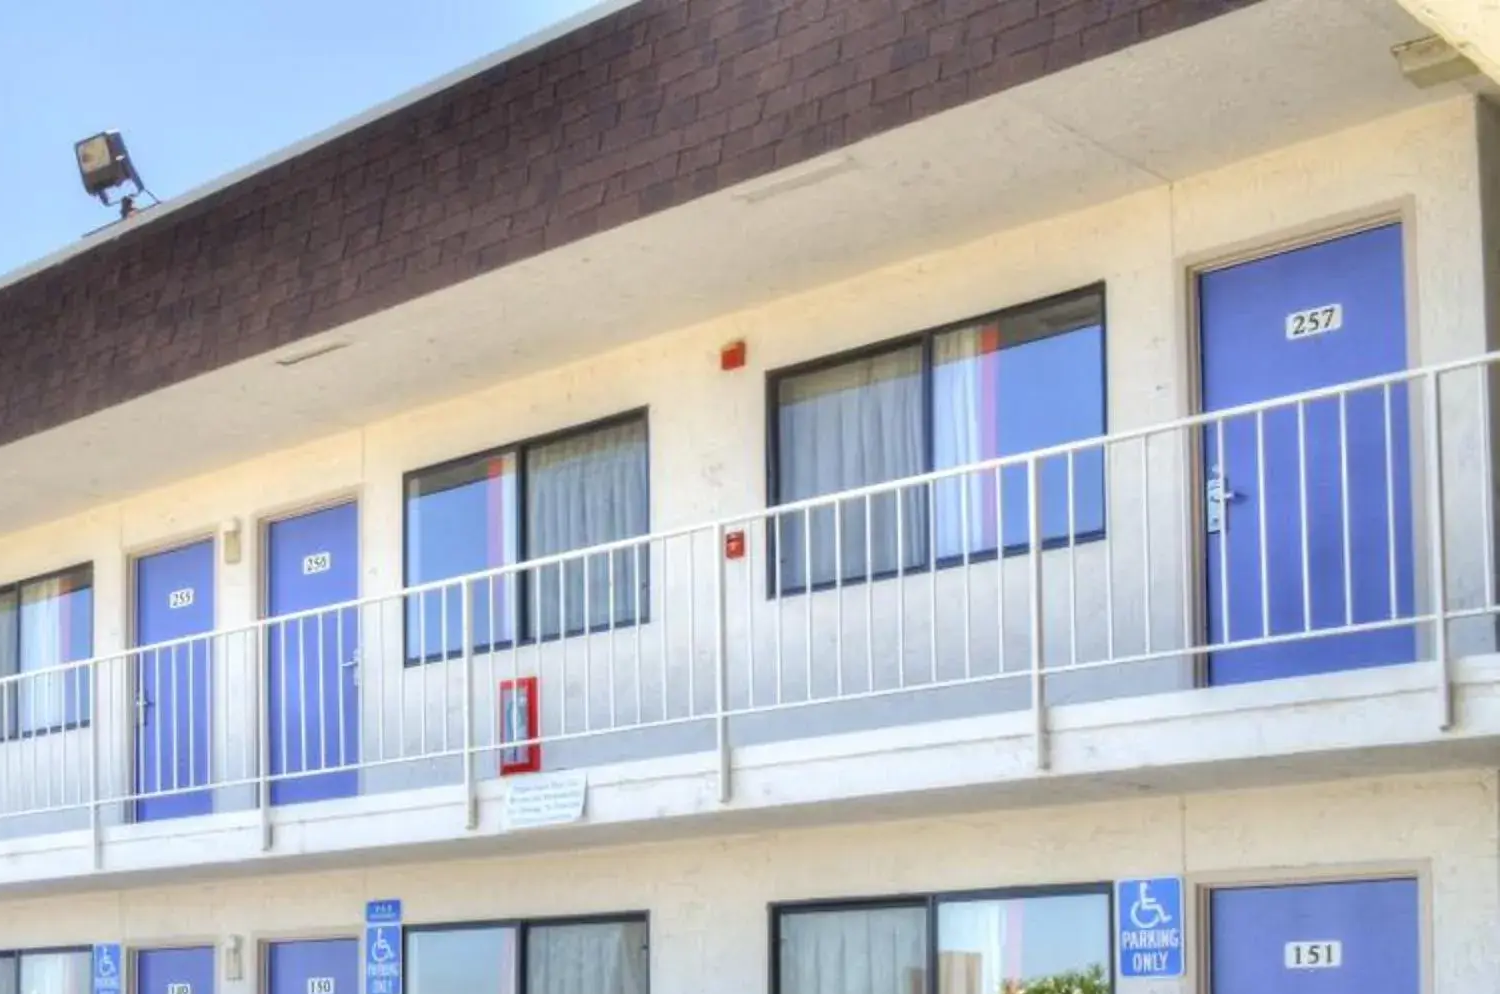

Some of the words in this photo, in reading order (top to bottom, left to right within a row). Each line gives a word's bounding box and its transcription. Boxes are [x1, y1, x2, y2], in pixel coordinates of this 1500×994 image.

[1292, 307, 1335, 336] 257
[1121, 928, 1179, 950] PARKING
[1132, 950, 1169, 973] ONLY
[1293, 943, 1333, 965] 151
